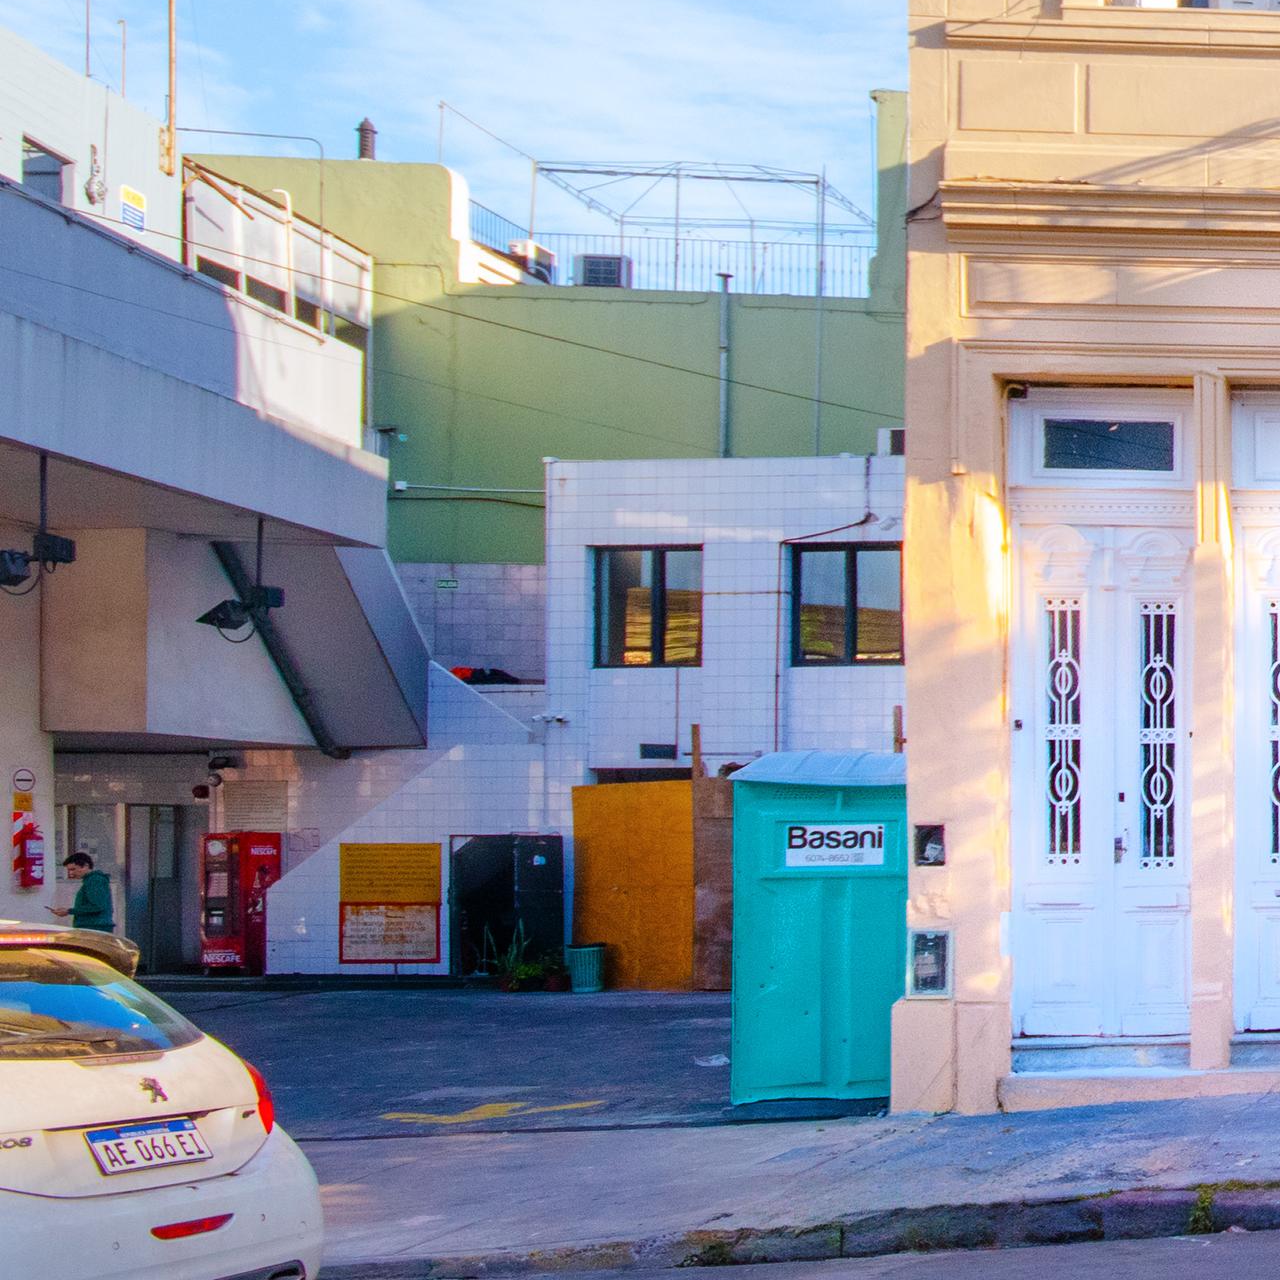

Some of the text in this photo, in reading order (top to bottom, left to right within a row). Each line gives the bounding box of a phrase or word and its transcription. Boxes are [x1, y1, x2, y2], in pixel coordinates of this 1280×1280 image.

[788, 825, 883, 849] Basani
[0, 1137, 32, 1149] 08
[103, 1140, 136, 1168] AE
[136, 1134, 178, 1162] 066
